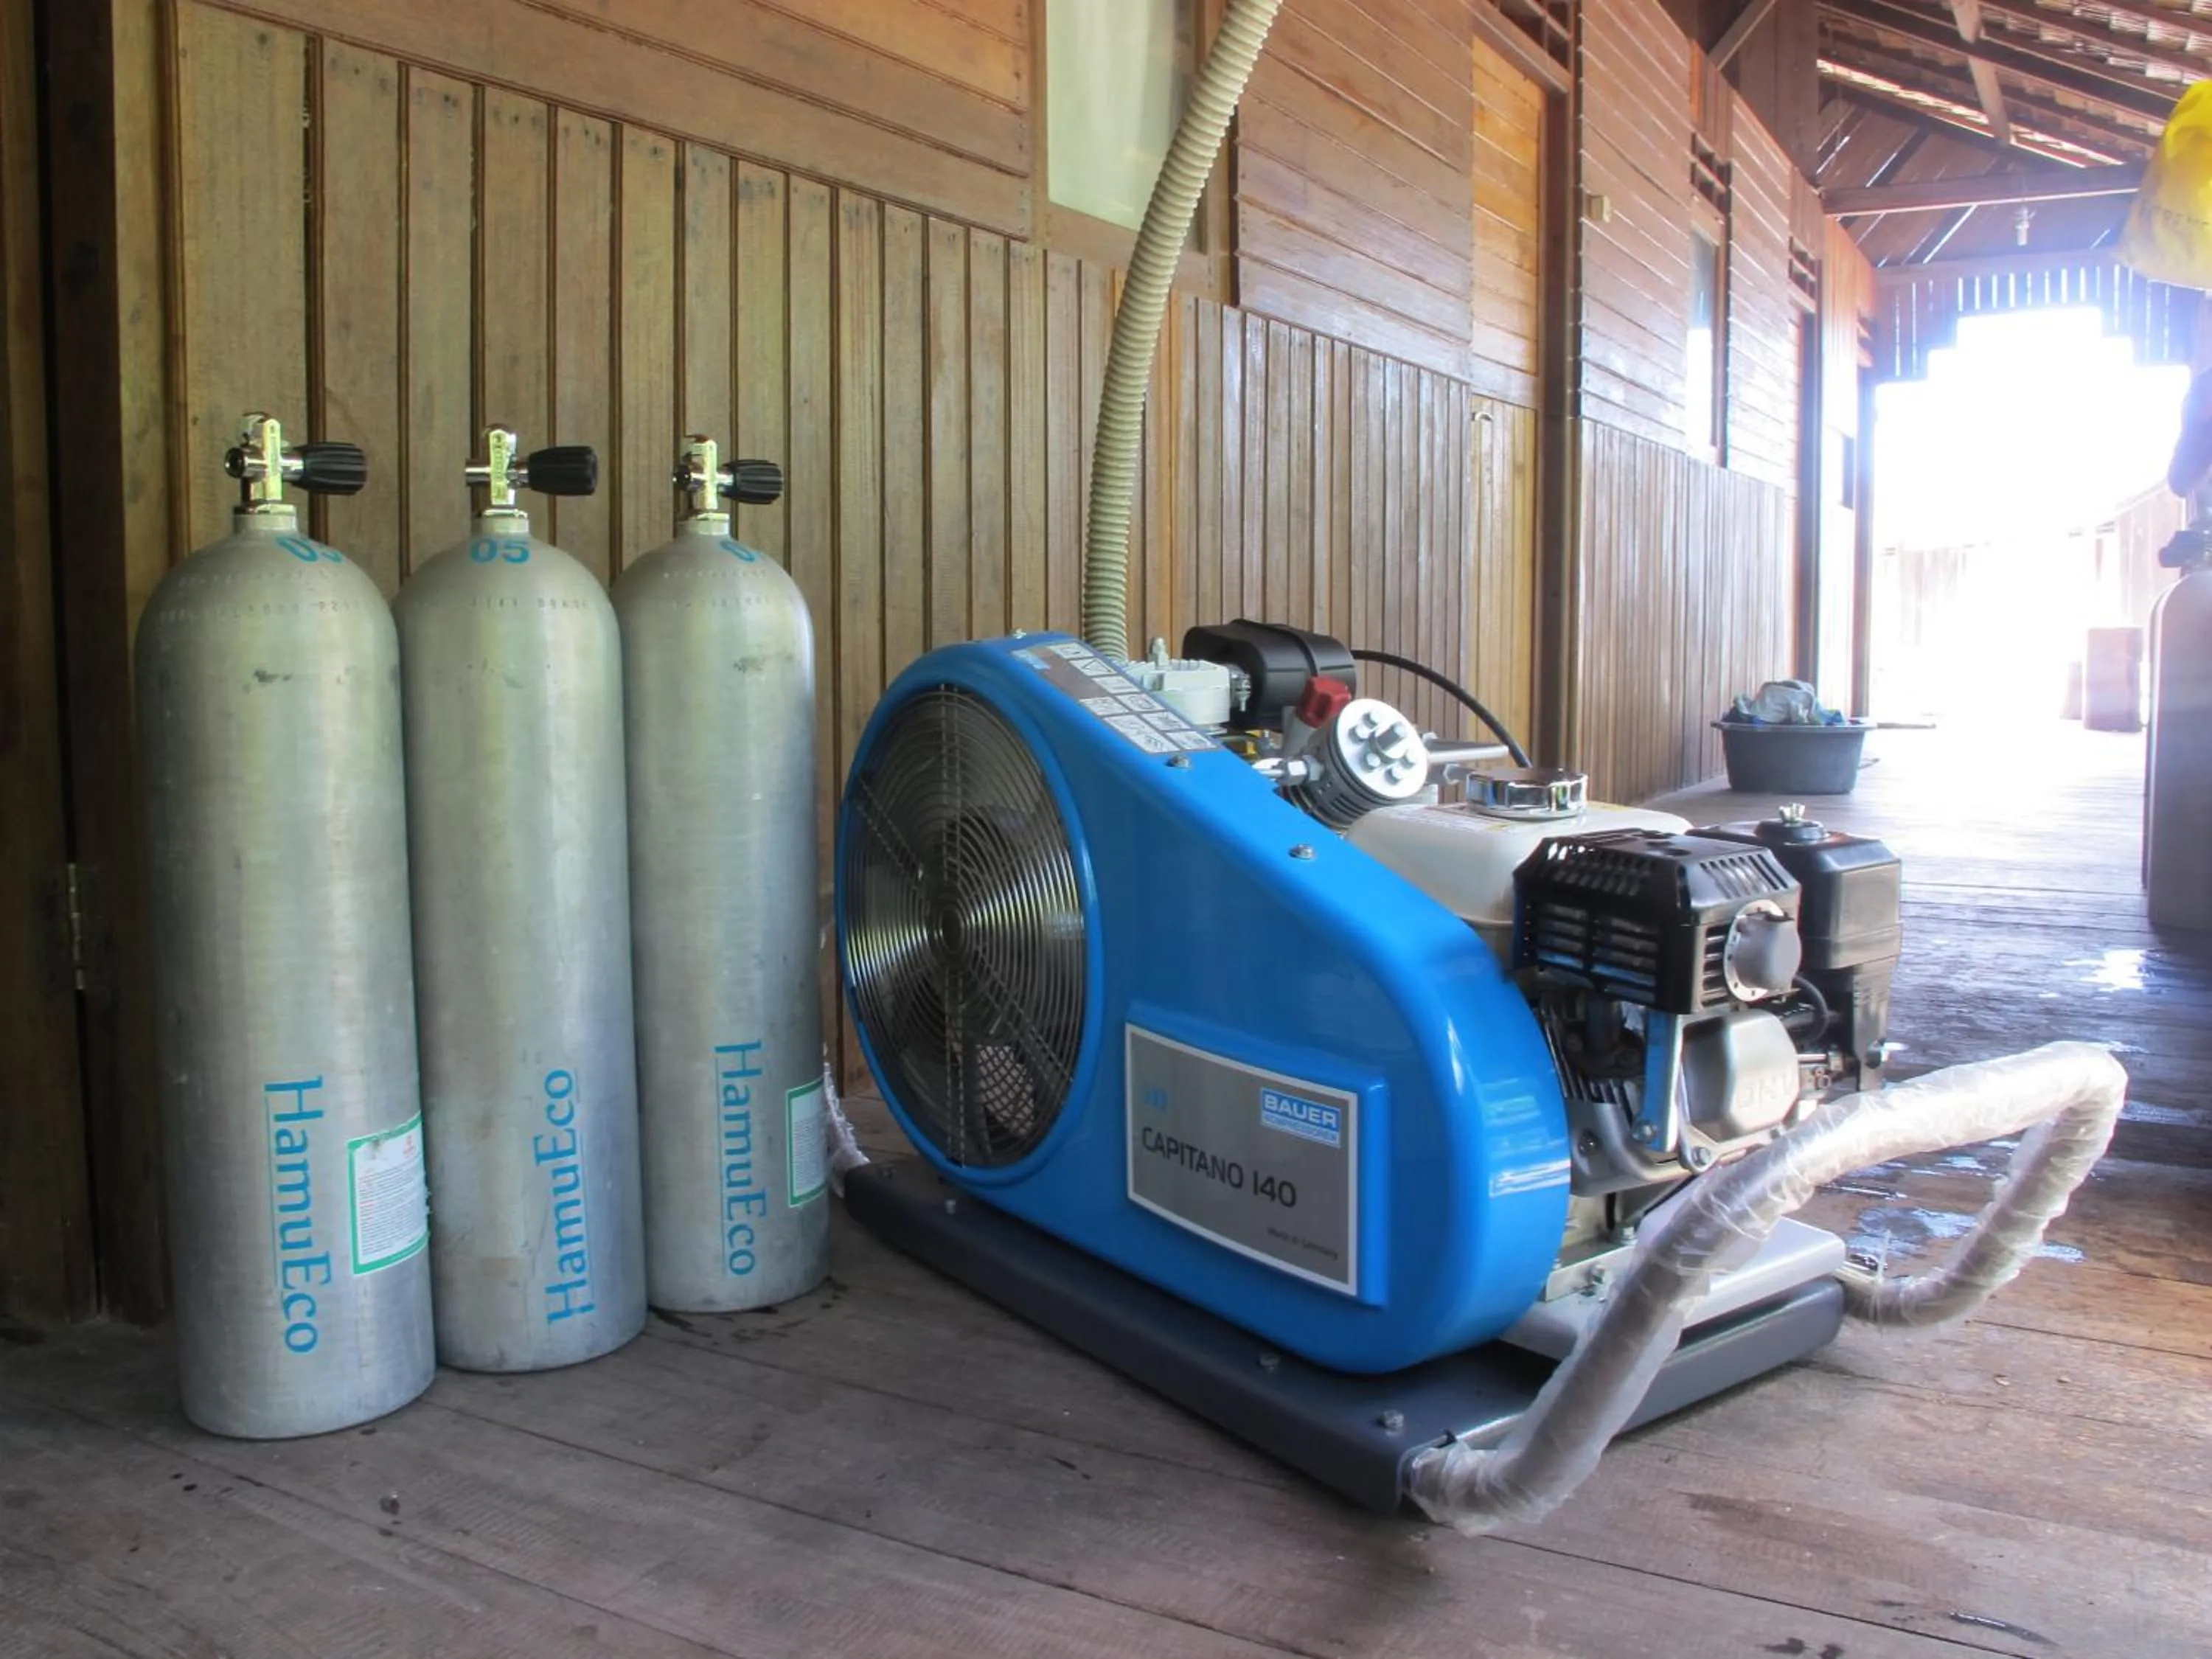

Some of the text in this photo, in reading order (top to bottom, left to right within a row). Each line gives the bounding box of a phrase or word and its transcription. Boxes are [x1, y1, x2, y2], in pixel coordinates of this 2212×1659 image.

[470, 538, 530, 565] 05
[714, 1040, 768, 1276] HamuEco
[1142, 1126, 1243, 1189] CAPITANO
[1253, 1170, 1297, 1208] 140
[1265, 1093, 1337, 1129] BAUER
[265, 1076, 332, 1354] HamuEco
[533, 1068, 597, 1325] HamuEco
